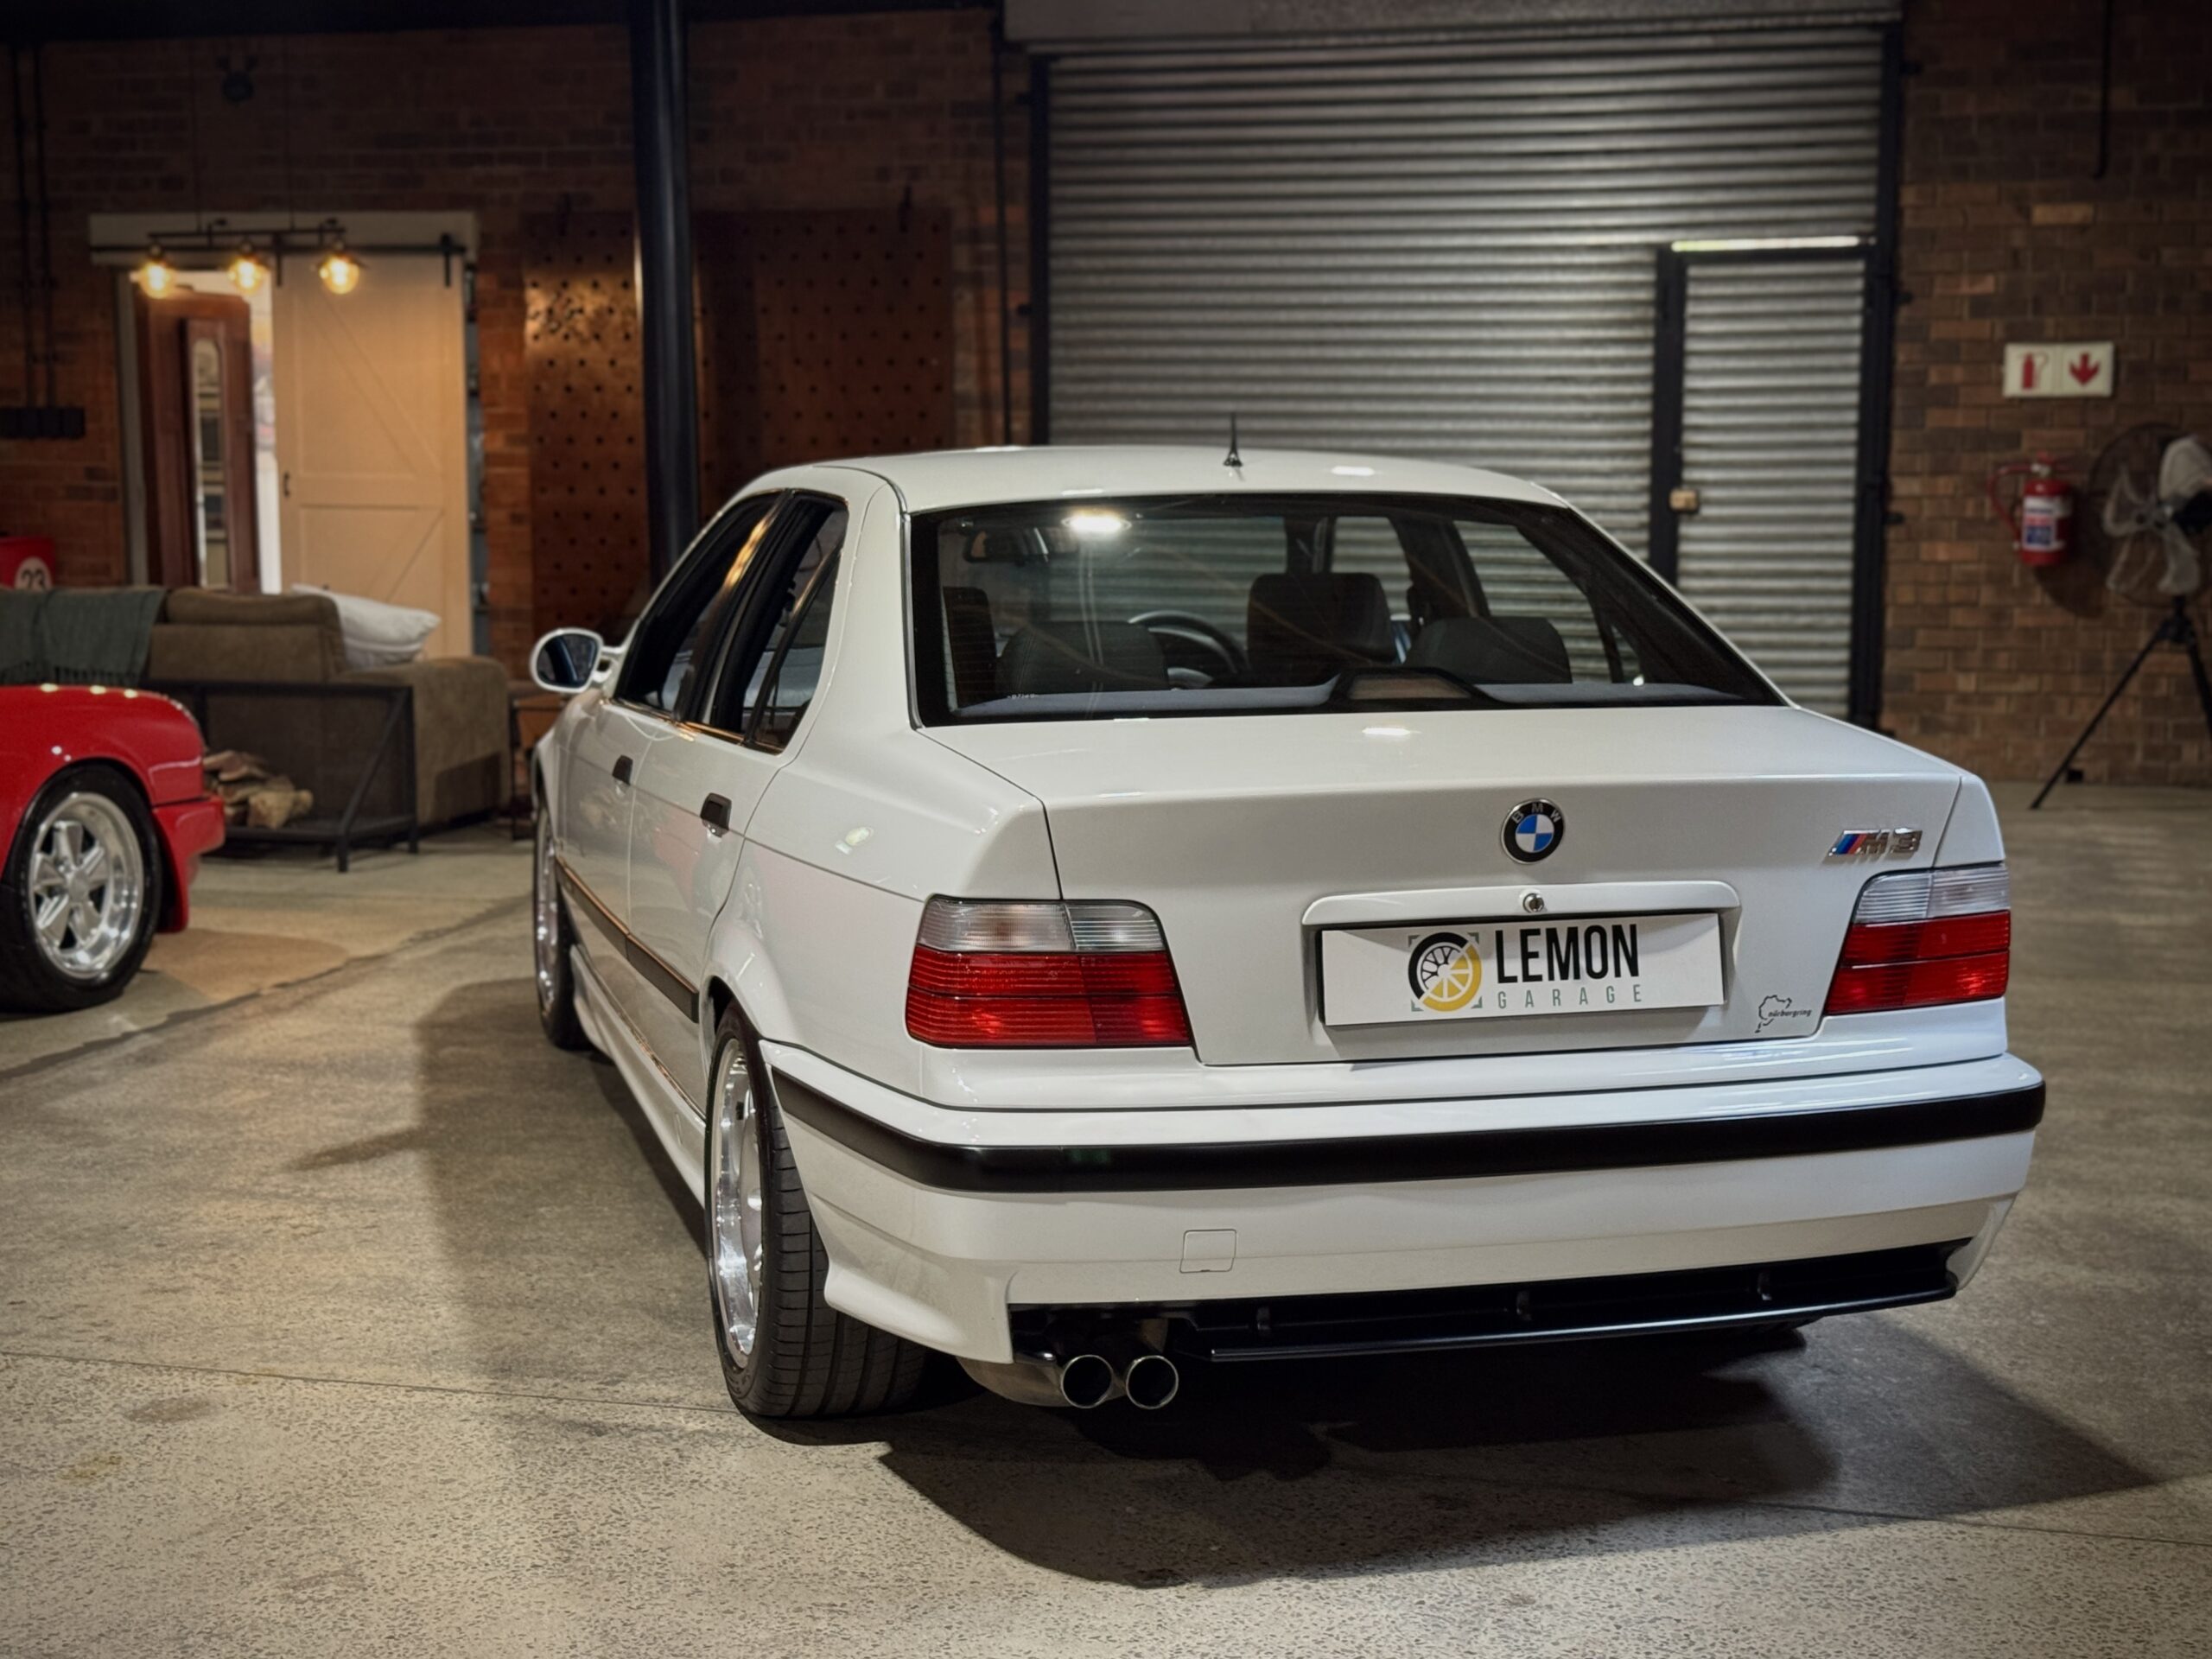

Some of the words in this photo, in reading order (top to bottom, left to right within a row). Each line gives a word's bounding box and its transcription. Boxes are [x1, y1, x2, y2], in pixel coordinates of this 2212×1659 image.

[1511, 803, 1561, 823] BMW
[1853, 829, 1923, 855] M3
[1495, 924, 1639, 983] LEMON
[1497, 984, 1642, 1009] GARAGE
